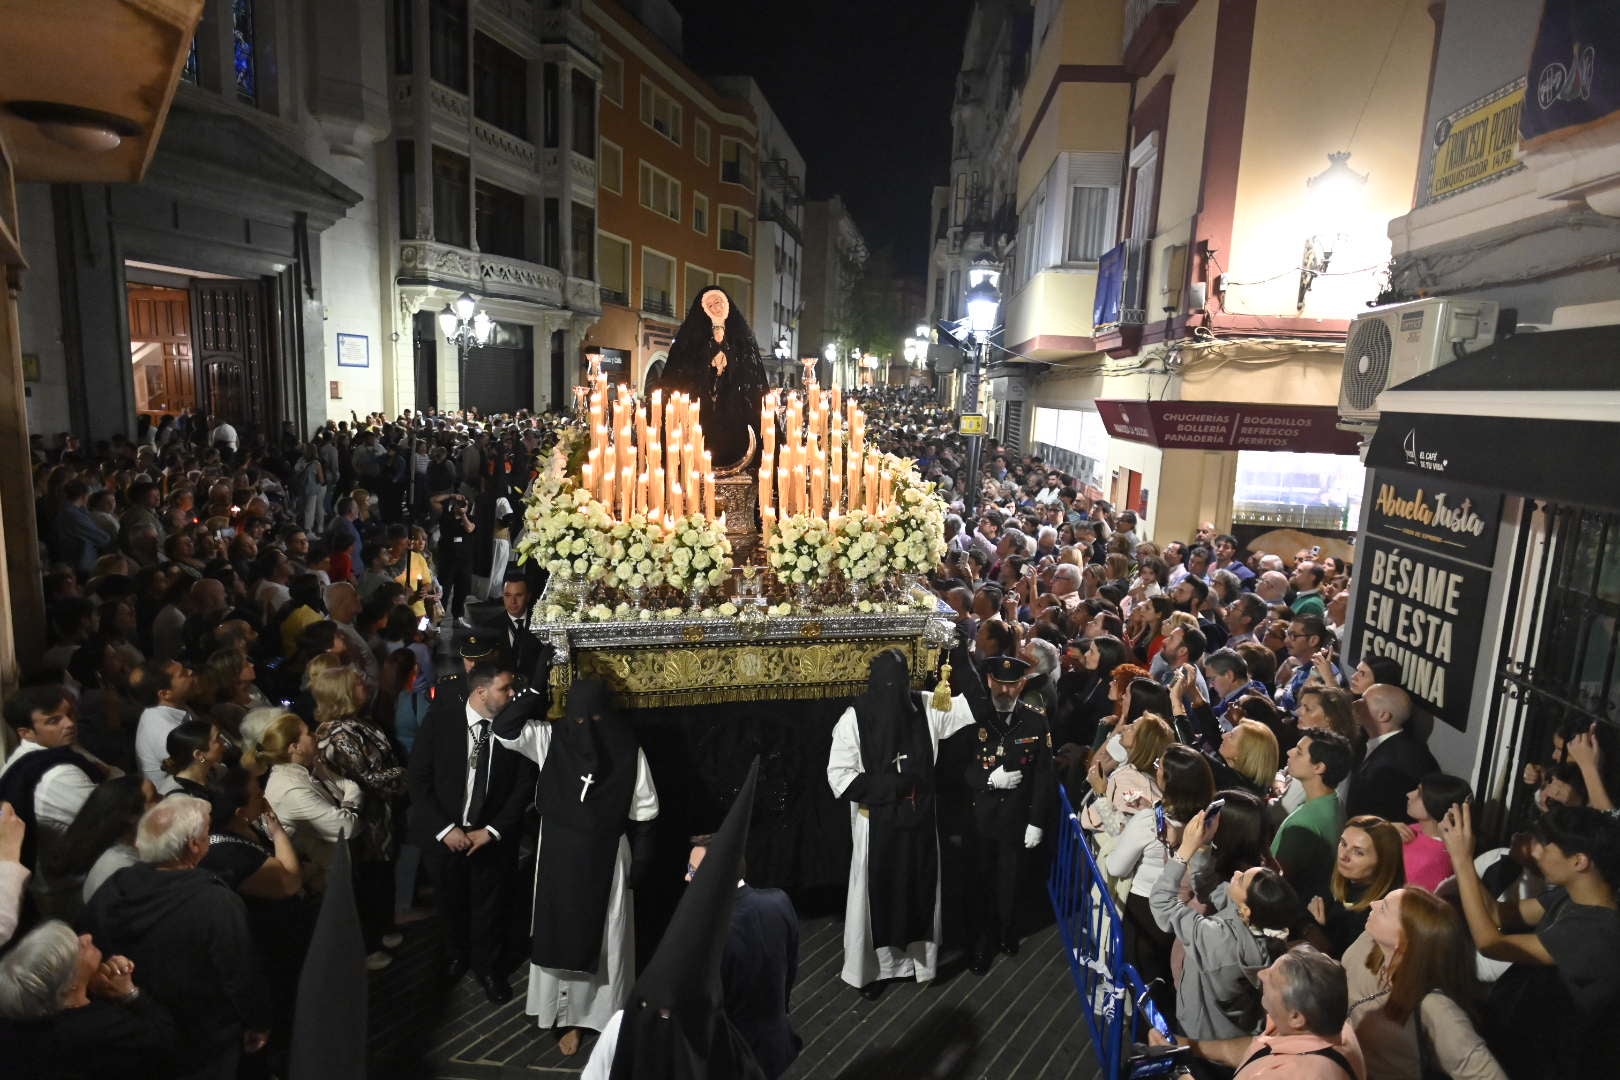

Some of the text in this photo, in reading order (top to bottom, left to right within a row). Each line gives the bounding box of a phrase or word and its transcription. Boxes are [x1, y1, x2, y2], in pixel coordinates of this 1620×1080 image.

[1162, 412, 1230, 424] CHUCHERÍAS
[1243, 416, 1312, 427] BOCADILLOS
[1176, 424, 1227, 433] BOLLERÍA
[1240, 426, 1300, 437] REFRESCOS
[1164, 433, 1225, 444] PANADERÍA
[1238, 436, 1288, 447] PERRITOS
[1375, 483, 1485, 537] Abuela Justa
[1370, 548, 1464, 616] BÉSAME
[1365, 590, 1454, 664] EN ESTA
